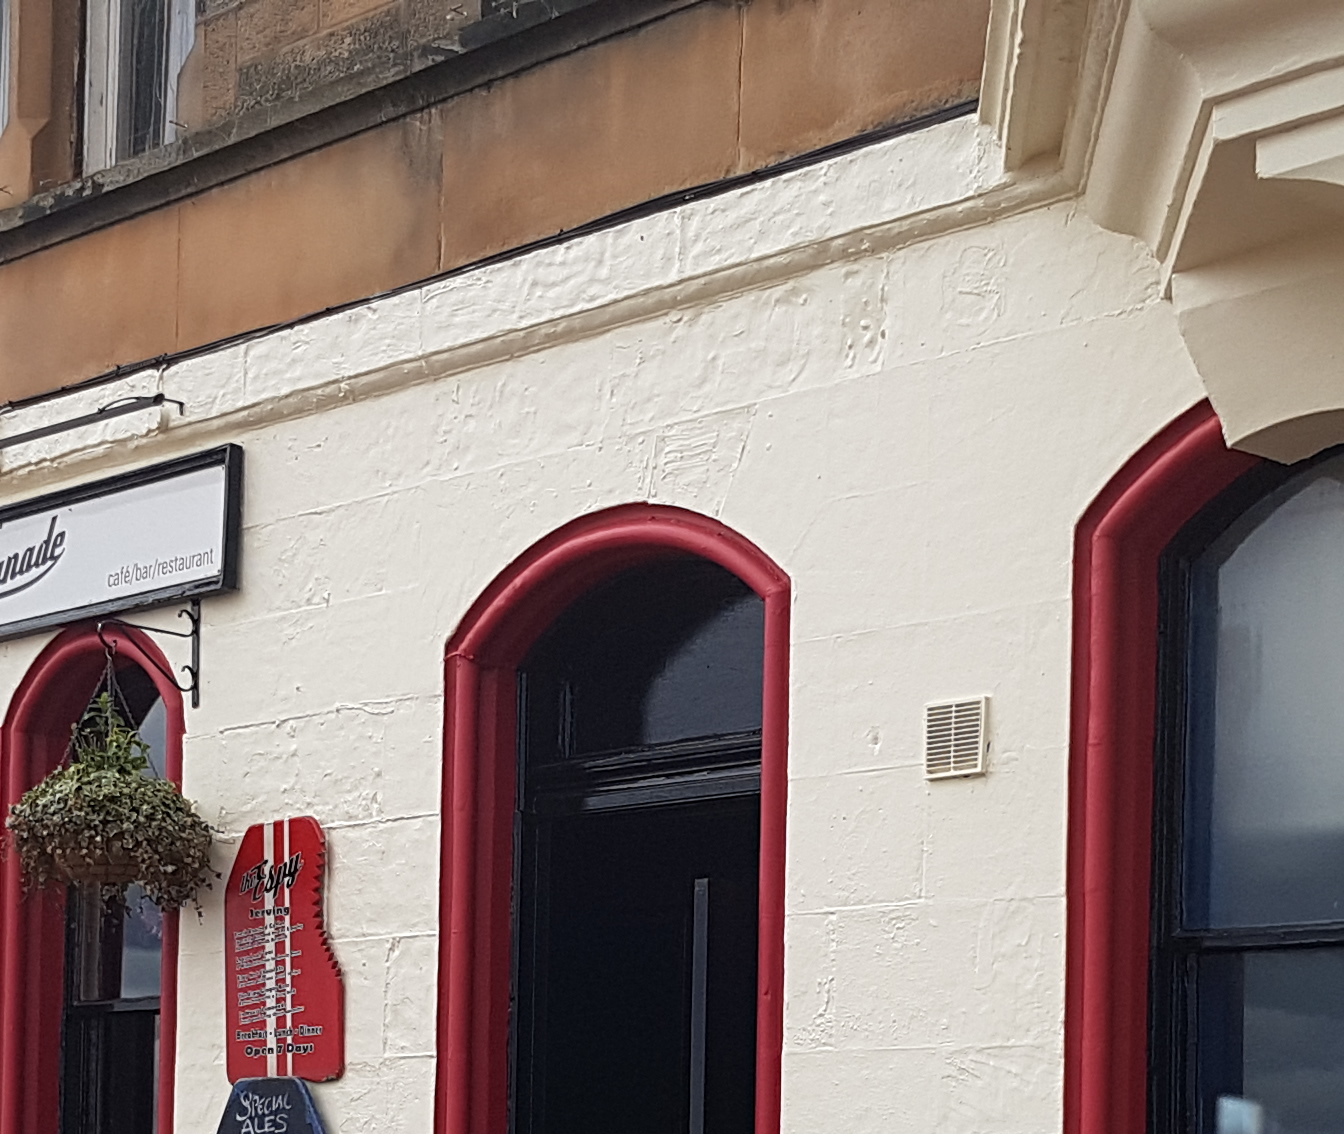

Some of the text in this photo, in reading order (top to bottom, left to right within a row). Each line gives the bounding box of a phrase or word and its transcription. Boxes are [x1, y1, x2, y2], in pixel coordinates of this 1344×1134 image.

[251, 851, 304, 903] Espy
[249, 905, 291, 919] Serving
[245, 1042, 314, 1058] Open 7 Days
